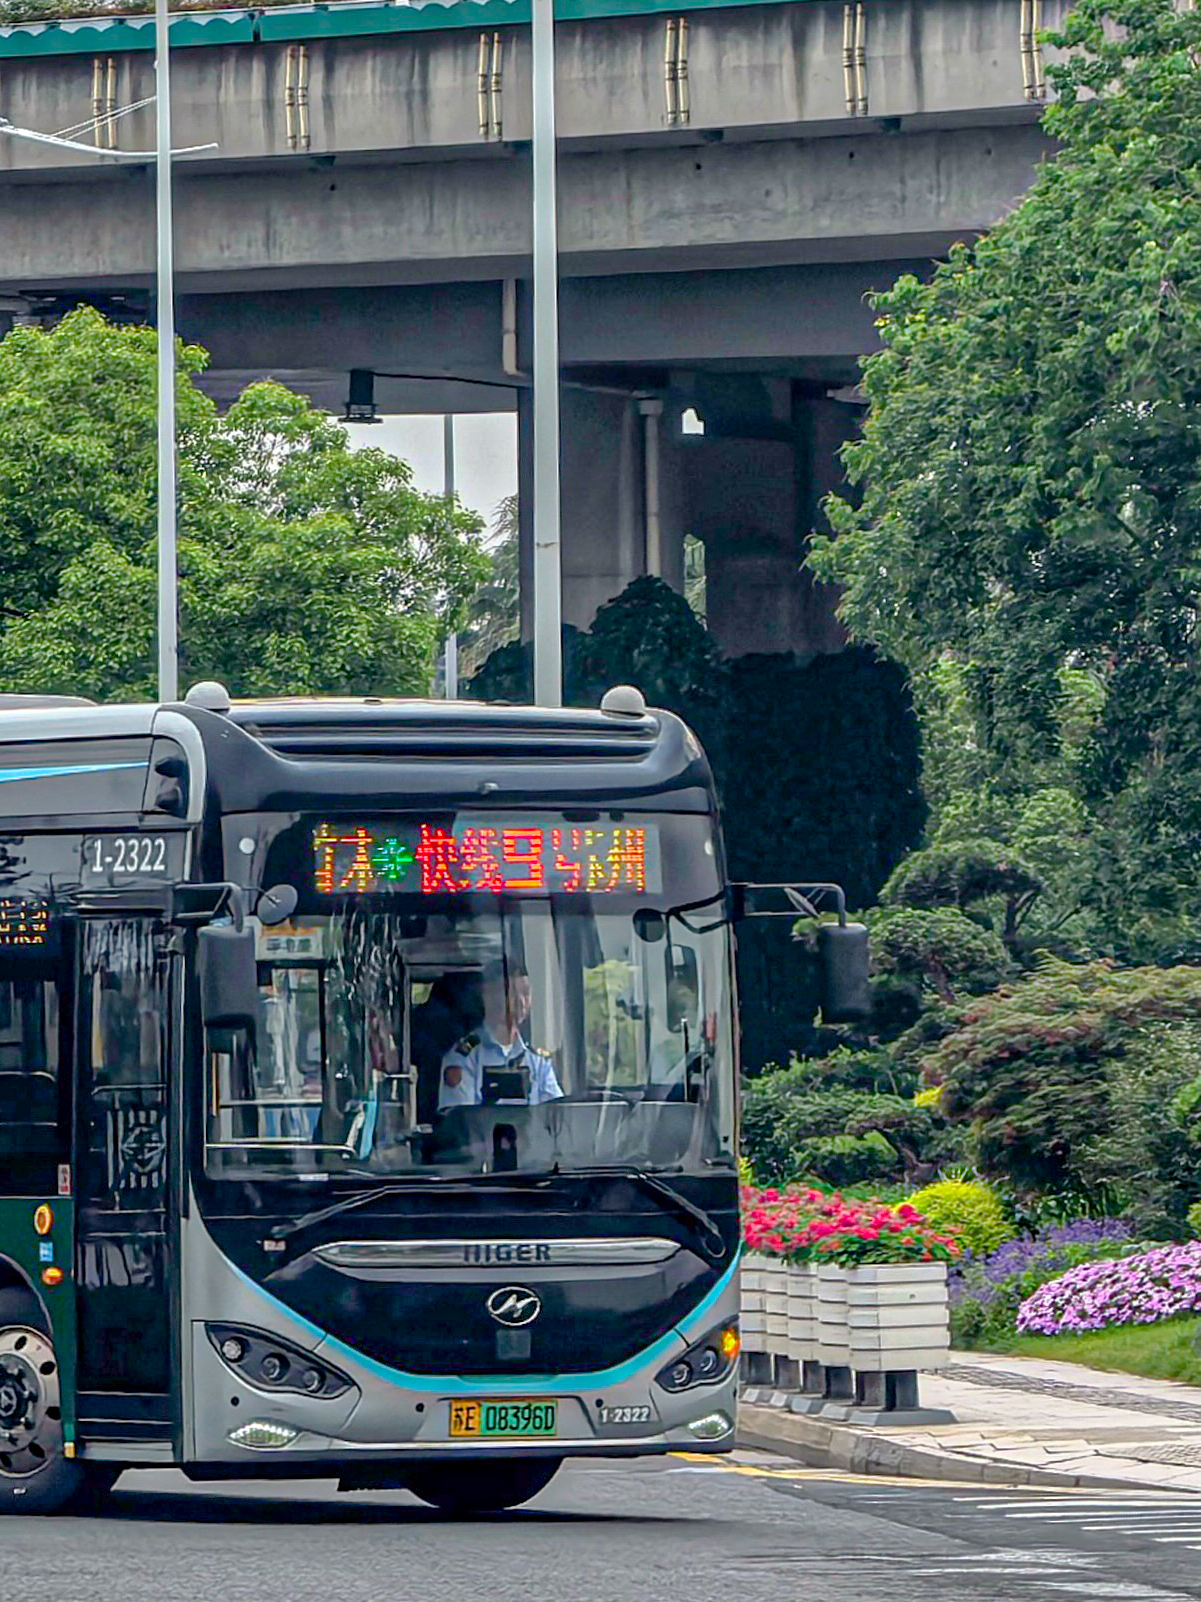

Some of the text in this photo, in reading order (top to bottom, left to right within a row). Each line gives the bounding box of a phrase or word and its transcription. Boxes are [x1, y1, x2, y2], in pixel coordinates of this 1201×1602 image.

[91, 837, 165, 872] 1-2322
[462, 1244, 551, 1263] HIGER
[485, 1405, 555, 1431] 08396D
[601, 1407, 649, 1423] 1-2322
